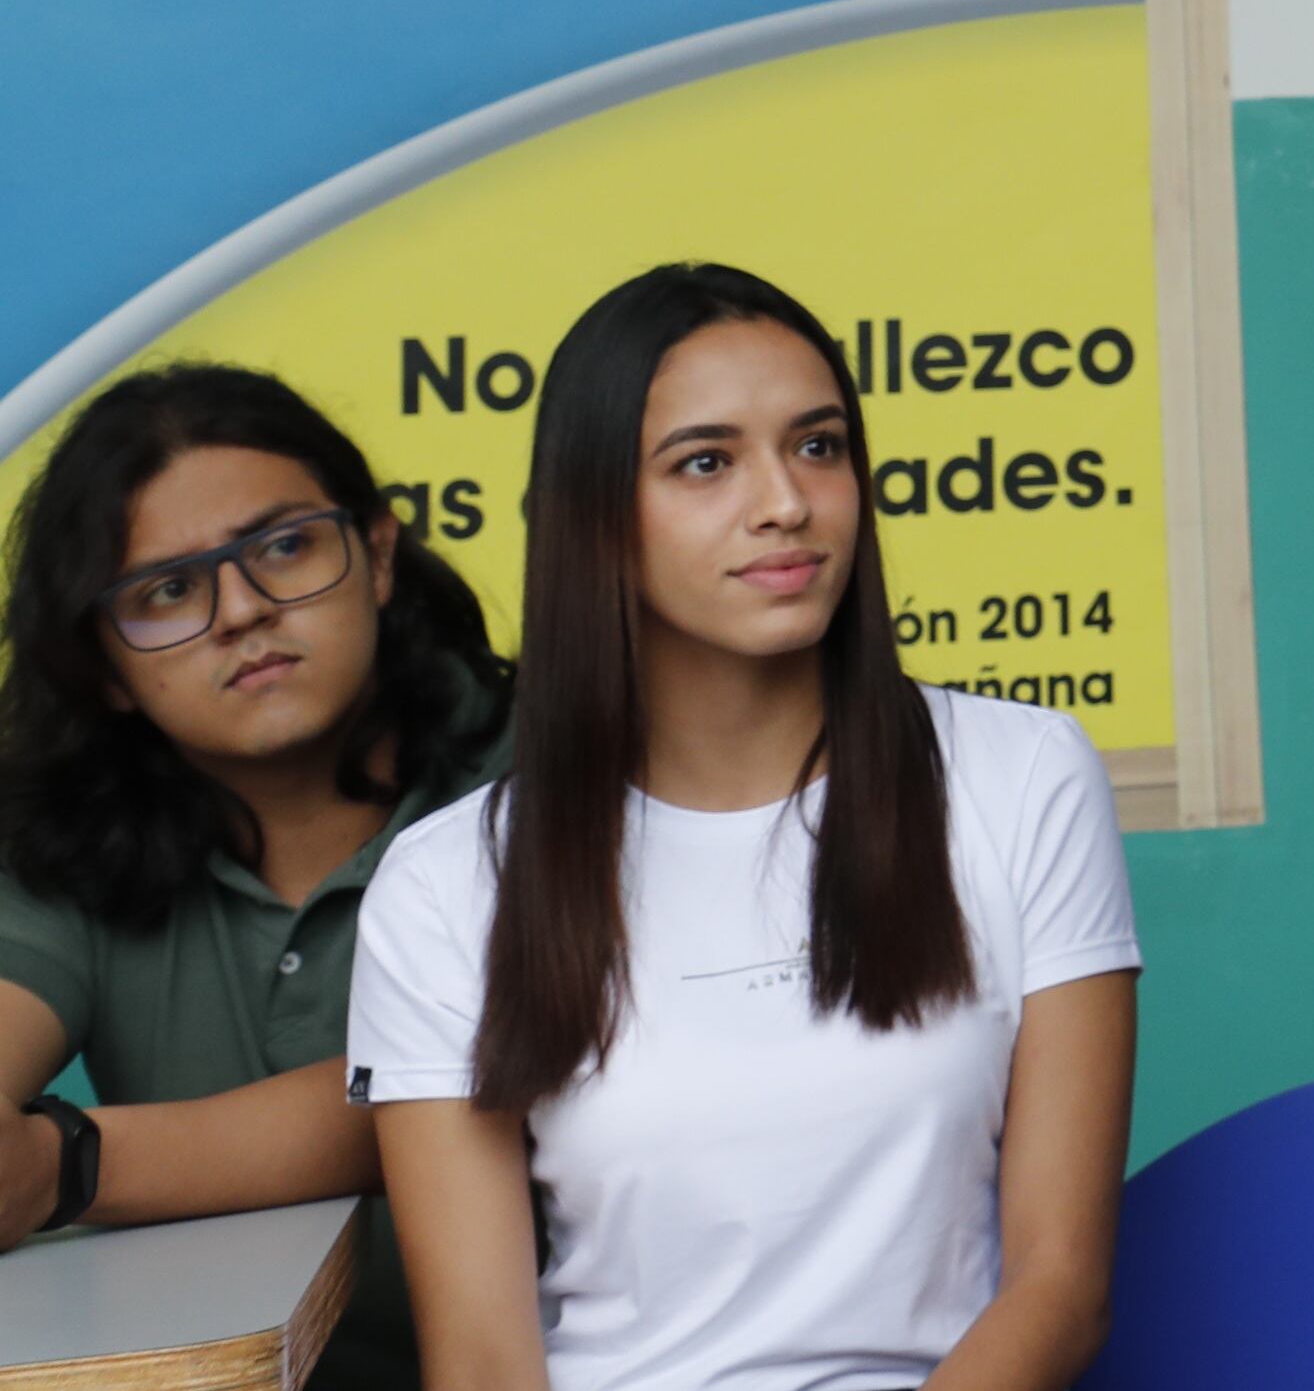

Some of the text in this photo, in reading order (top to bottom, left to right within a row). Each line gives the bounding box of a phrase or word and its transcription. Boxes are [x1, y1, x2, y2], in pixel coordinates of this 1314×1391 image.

[402, 318, 1135, 416] No llezco
[384, 436, 1133, 541] as ades.
[896, 589, 1114, 646] ón 2014
